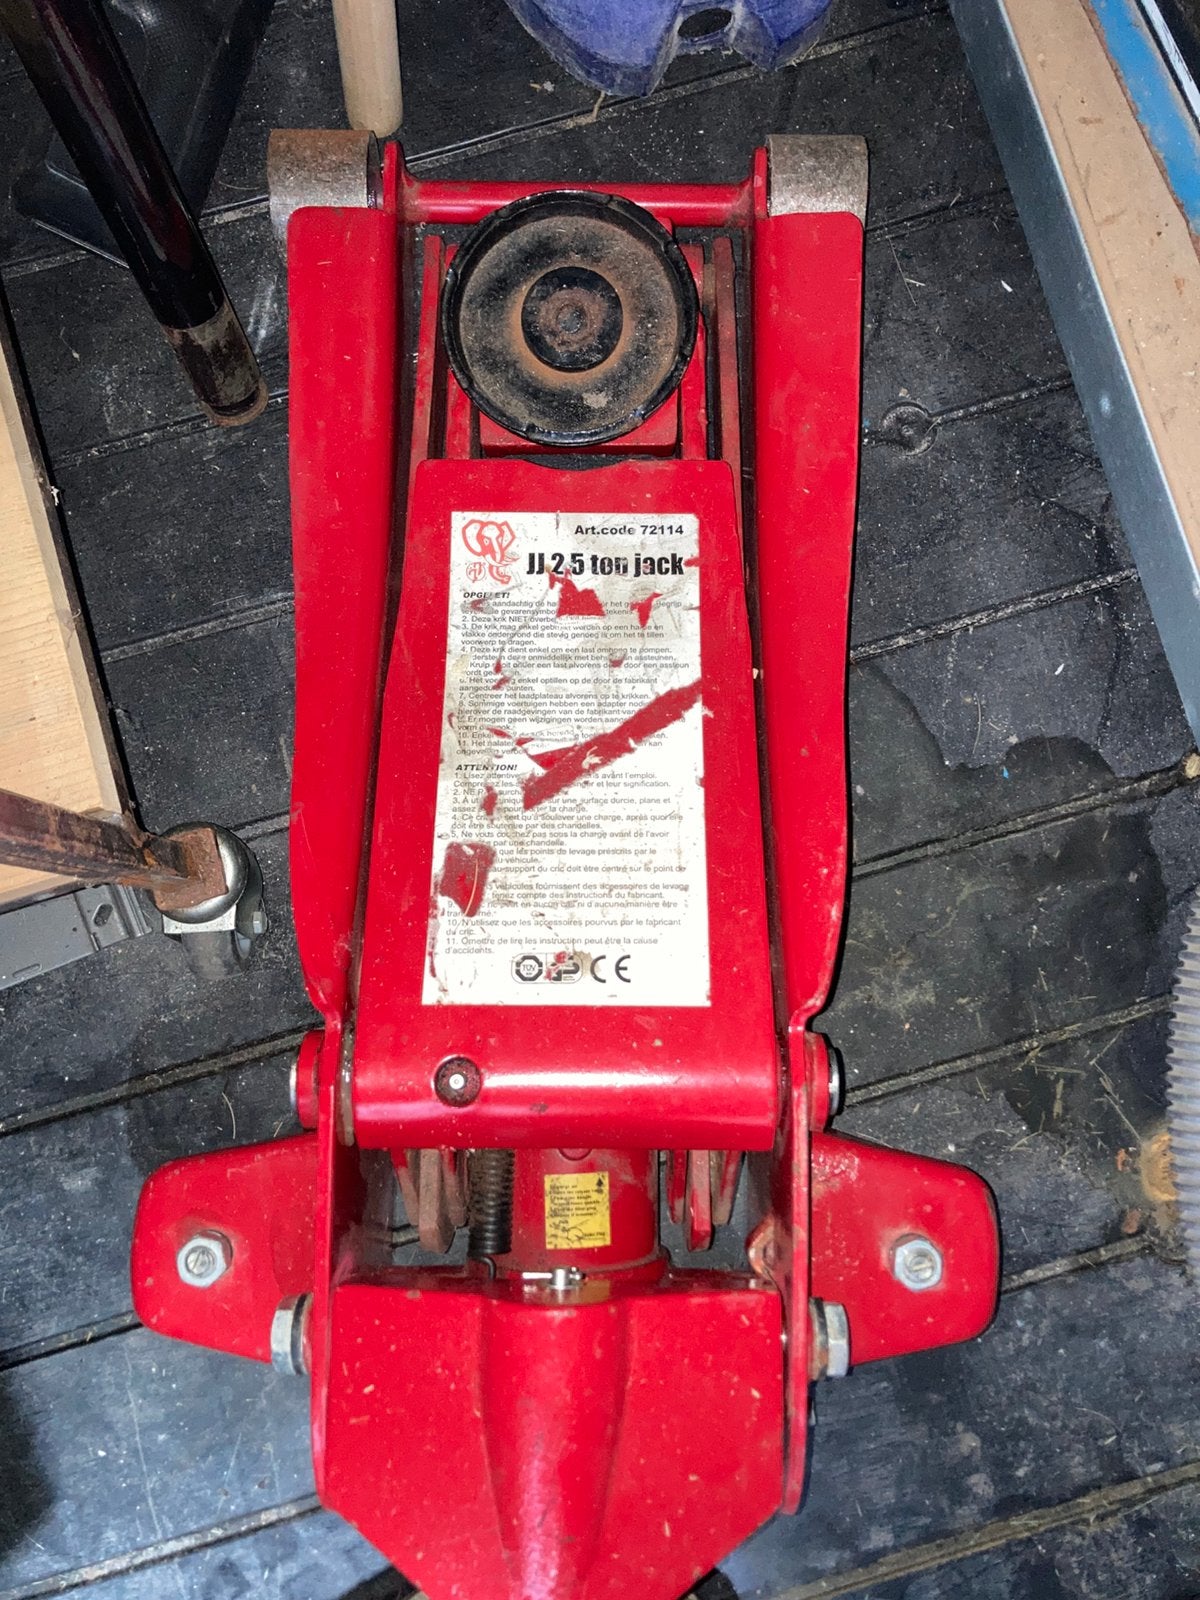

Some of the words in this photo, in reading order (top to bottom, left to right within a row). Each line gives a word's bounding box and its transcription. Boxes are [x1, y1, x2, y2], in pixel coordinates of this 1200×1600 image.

[574, 525, 636, 535] Art.code
[640, 525, 684, 535] 72114
[526, 553, 545, 575] JJ
[550, 553, 585, 575] 25
[590, 553, 628, 575] ton
[633, 553, 684, 578] jack
[492, 601, 534, 609] aandachtig
[488, 632, 531, 640] ondergrond
[547, 632, 568, 640] stevig
[596, 646, 627, 654] omhoog
[540, 677, 568, 685] optillen
[519, 692, 563, 700] laadplateau
[507, 700, 548, 708] voertuigen
[597, 700, 627, 708] adapter
[504, 708, 556, 716] raadgevingen
[529, 716, 572, 724] wijzigingen
[625, 772, 657, 780] l'emploi.
[623, 780, 671, 789] signification.
[610, 797, 637, 806] durcie,
[639, 797, 660, 806] plane
[559, 806, 588, 814] charge.
[594, 814, 623, 822] charge,
[579, 830, 607, 839] charge
[609, 830, 632, 838] avant
[530, 848, 554, 857] points
[569, 848, 596, 857] levage
[653, 865, 674, 874] point
[516, 892, 547, 900] compte
[446, 937, 459, 945] 11.
[461, 937, 495, 945] Omettre
[510, 937, 523, 945] lire
[525, 937, 537, 945] les
[540, 937, 582, 945] instruction
[584, 937, 603, 946] peut
